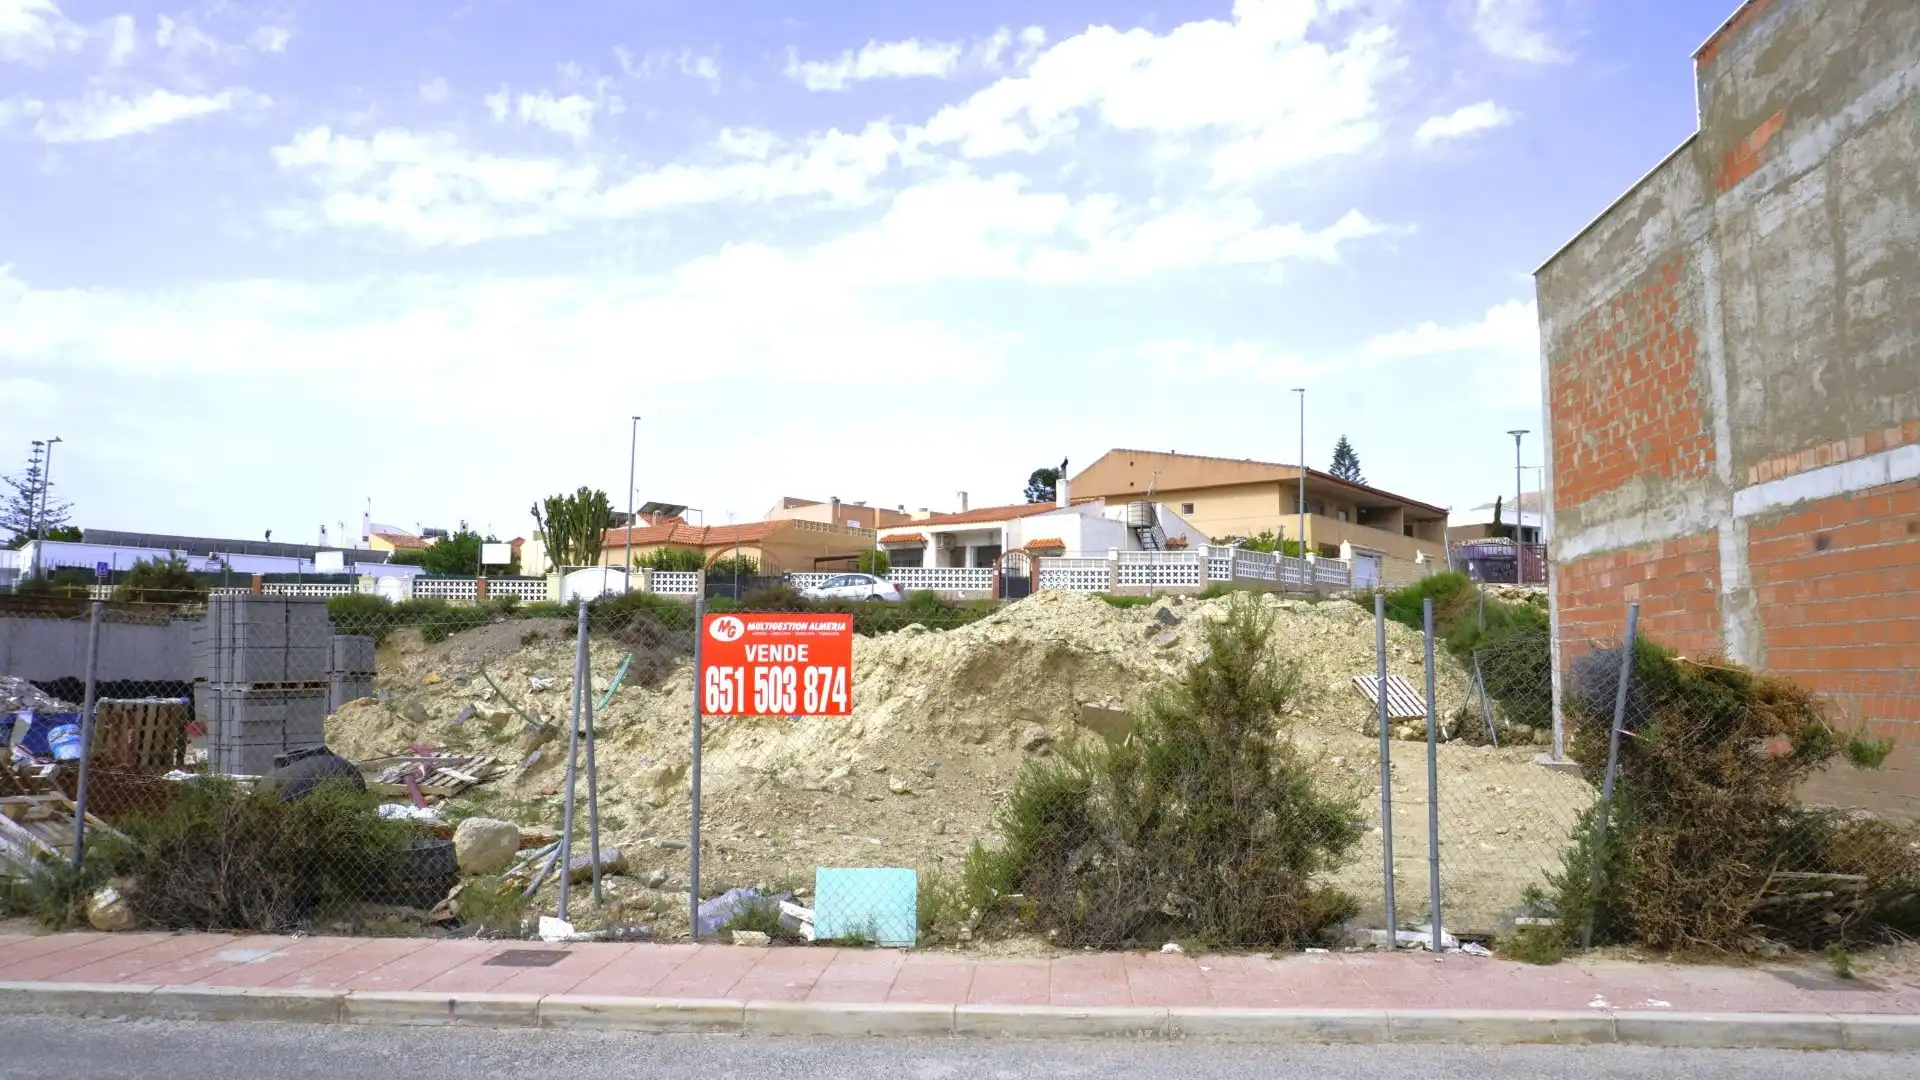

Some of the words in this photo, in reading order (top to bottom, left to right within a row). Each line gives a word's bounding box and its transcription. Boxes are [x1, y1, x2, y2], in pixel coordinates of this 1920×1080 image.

[809, 622, 846, 631] ALMERIA
[744, 644, 808, 662] VENDE
[705, 665, 744, 713] 651
[754, 665, 797, 713] 503
[803, 665, 847, 713] 874
